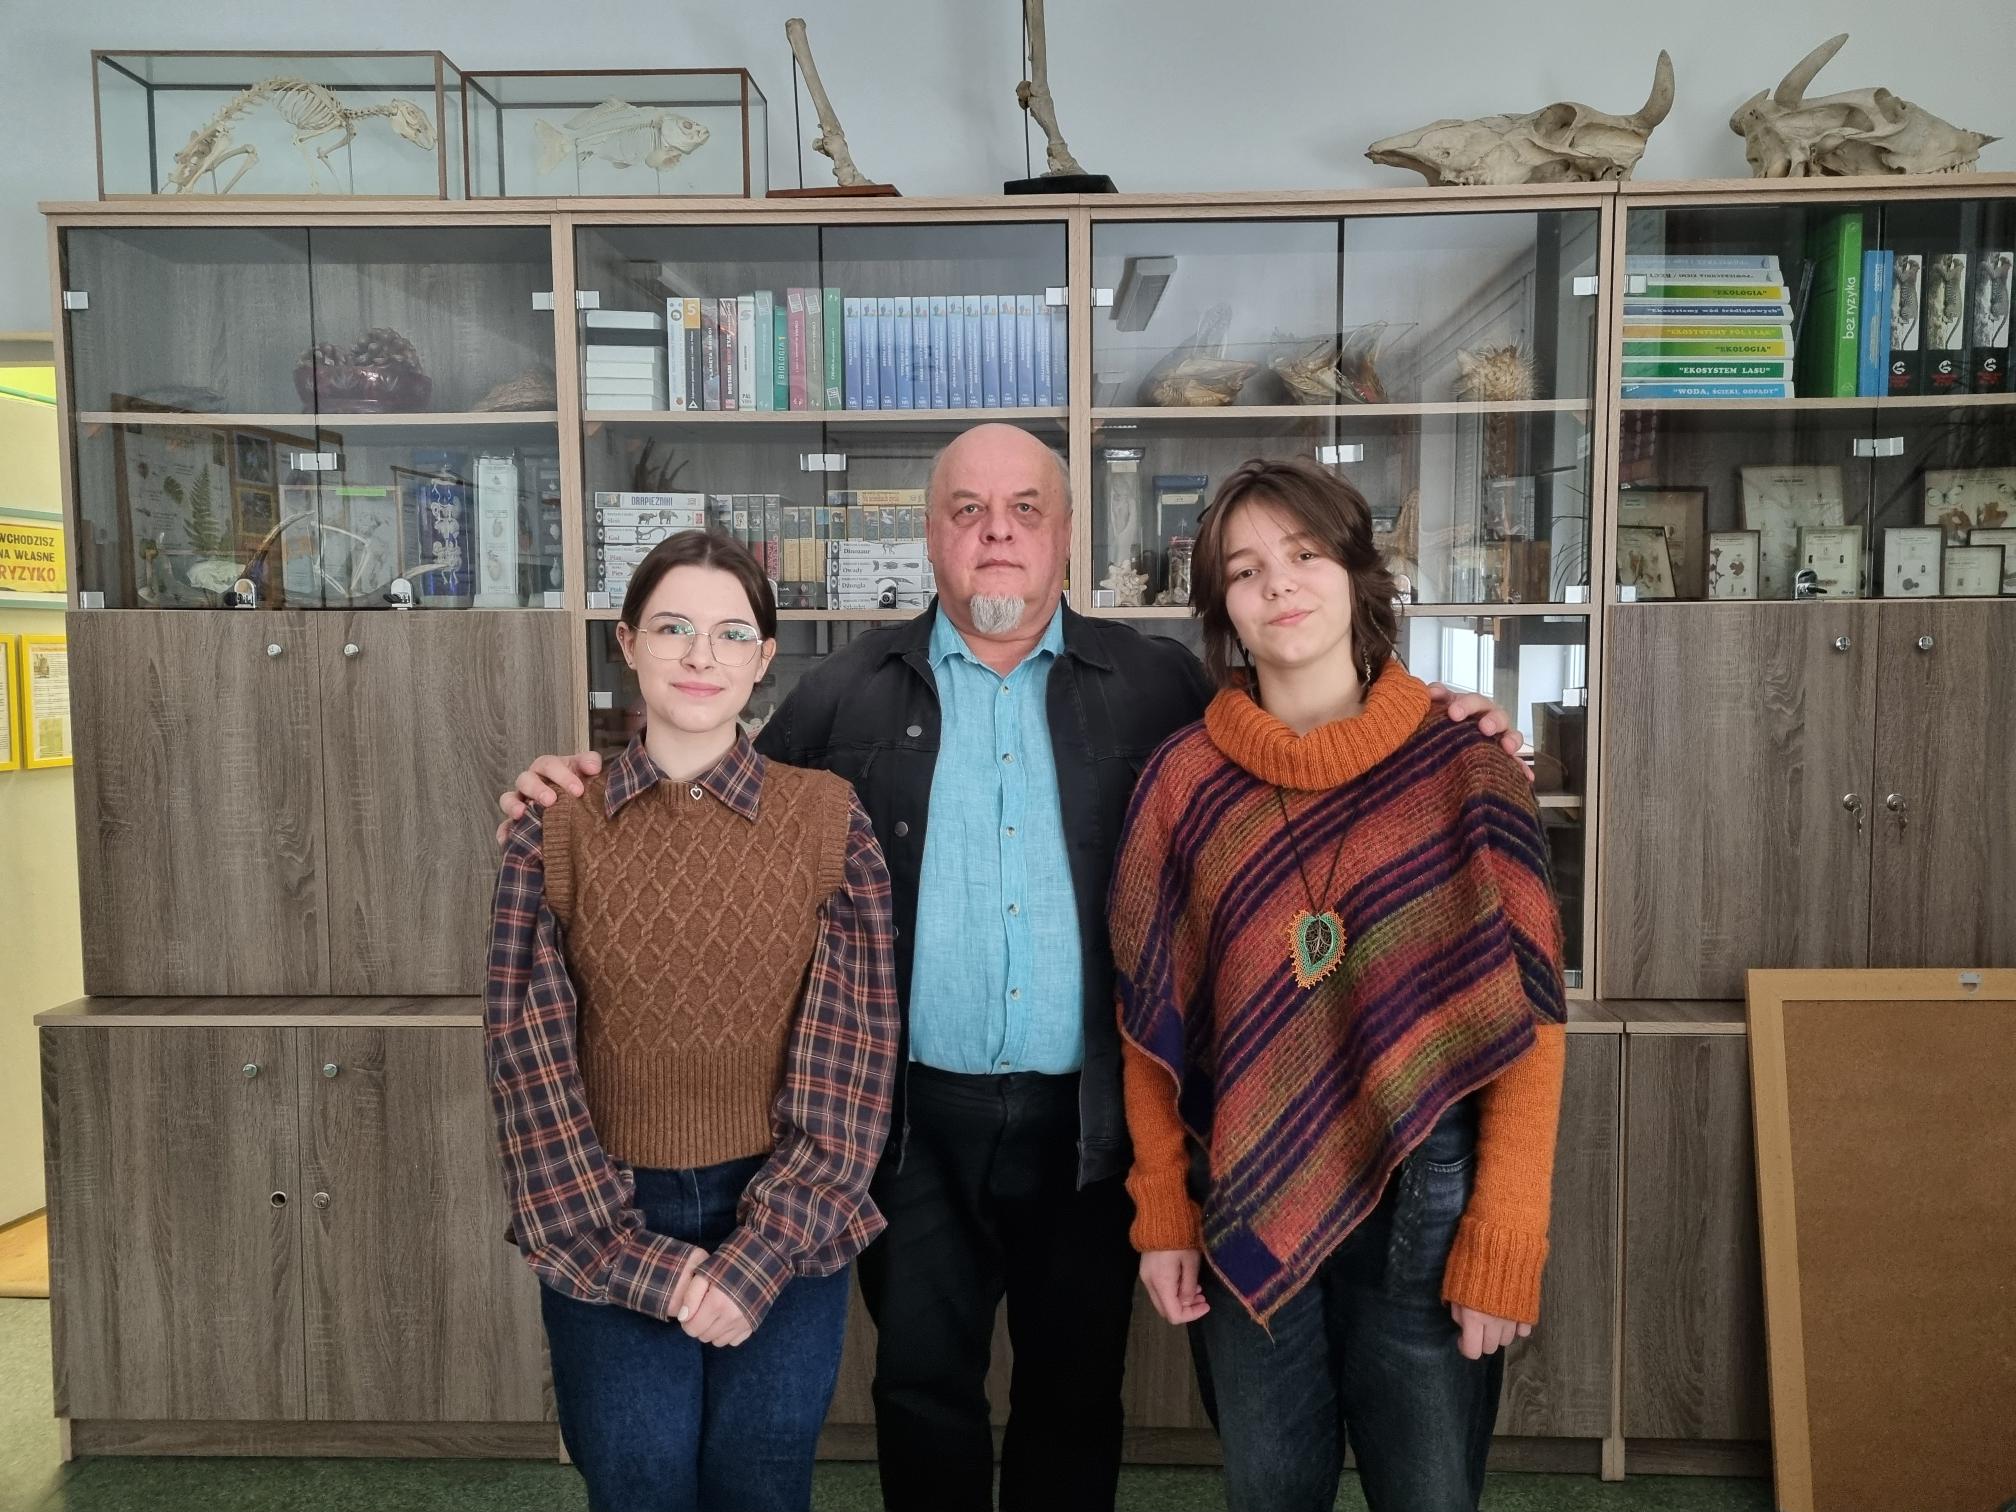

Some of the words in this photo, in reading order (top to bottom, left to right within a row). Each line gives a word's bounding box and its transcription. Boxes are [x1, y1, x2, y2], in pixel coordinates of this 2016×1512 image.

[1844, 276, 1858, 314] ryzyka
[1842, 315, 1855, 340] bez
[15, 550, 55, 563] WŁASNE
[0, 564, 56, 582] RYZYKO
